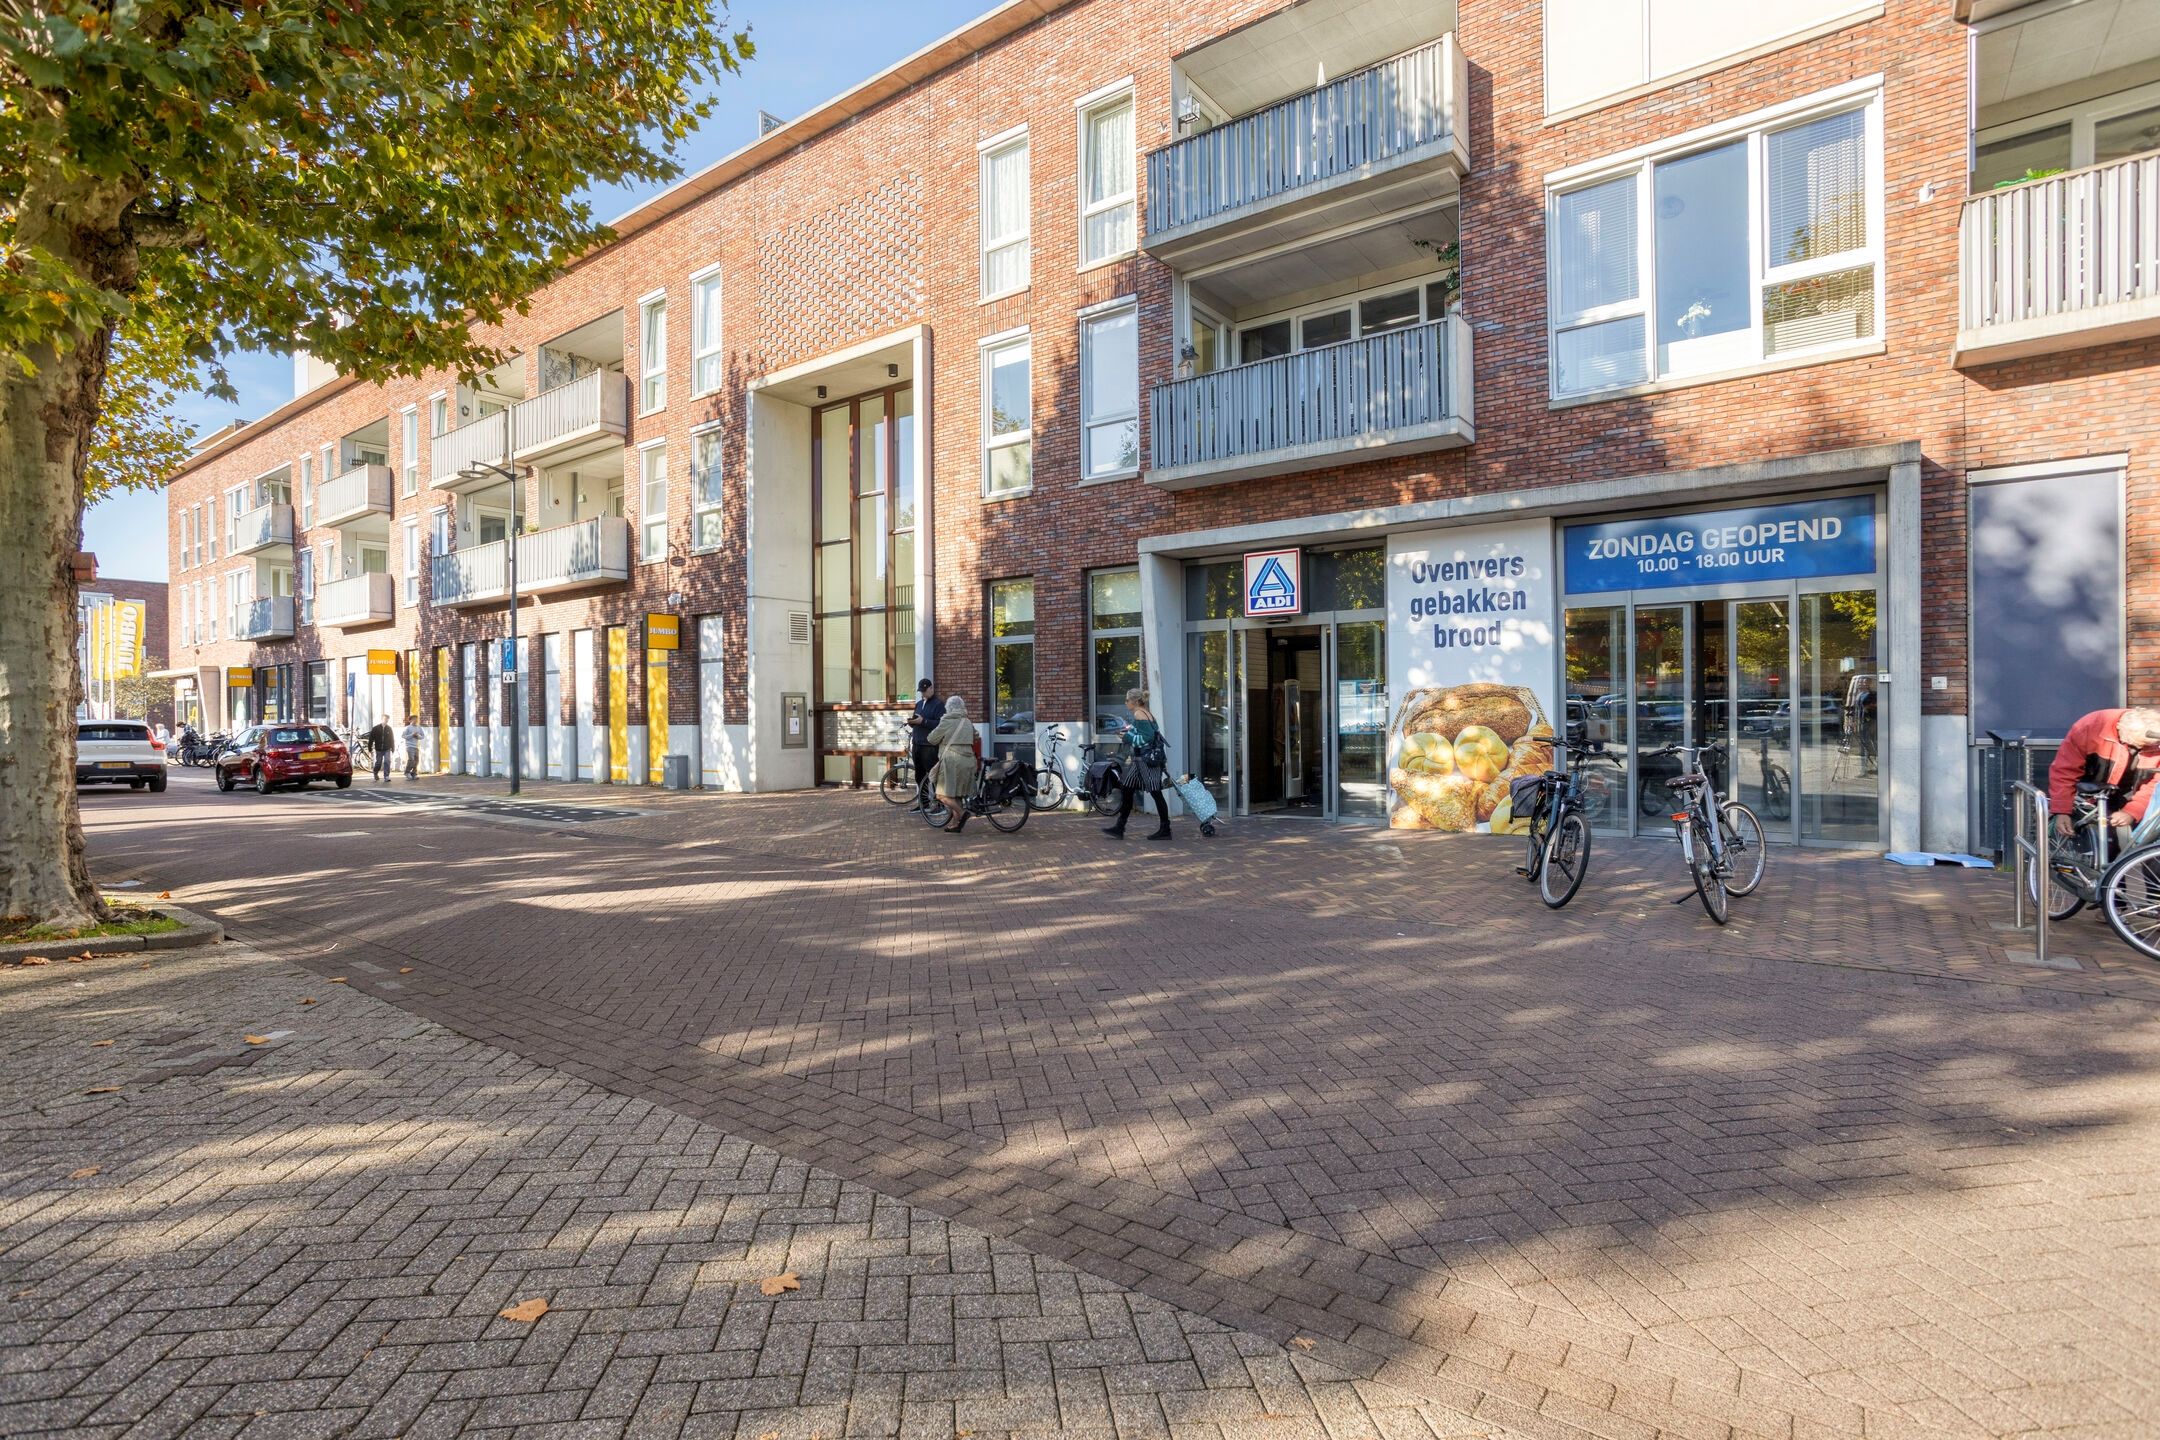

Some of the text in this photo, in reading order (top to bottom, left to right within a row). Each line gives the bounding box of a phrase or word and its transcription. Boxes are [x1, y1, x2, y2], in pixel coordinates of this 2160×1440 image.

[1588, 516, 1842, 560] ZONDAG GEOPEND
[1411, 556, 1525, 584] Ovenvers
[1636, 557, 1678, 574] 10.00
[1695, 551, 1740, 569] 18.00
[1744, 548, 1785, 565] UUR
[1254, 595, 1292, 609] ALDI
[1410, 587, 1527, 622] gebakken
[117, 605, 138, 675] JUMBO
[649, 626, 677, 635] JUMBO
[1434, 620, 1501, 648] brood
